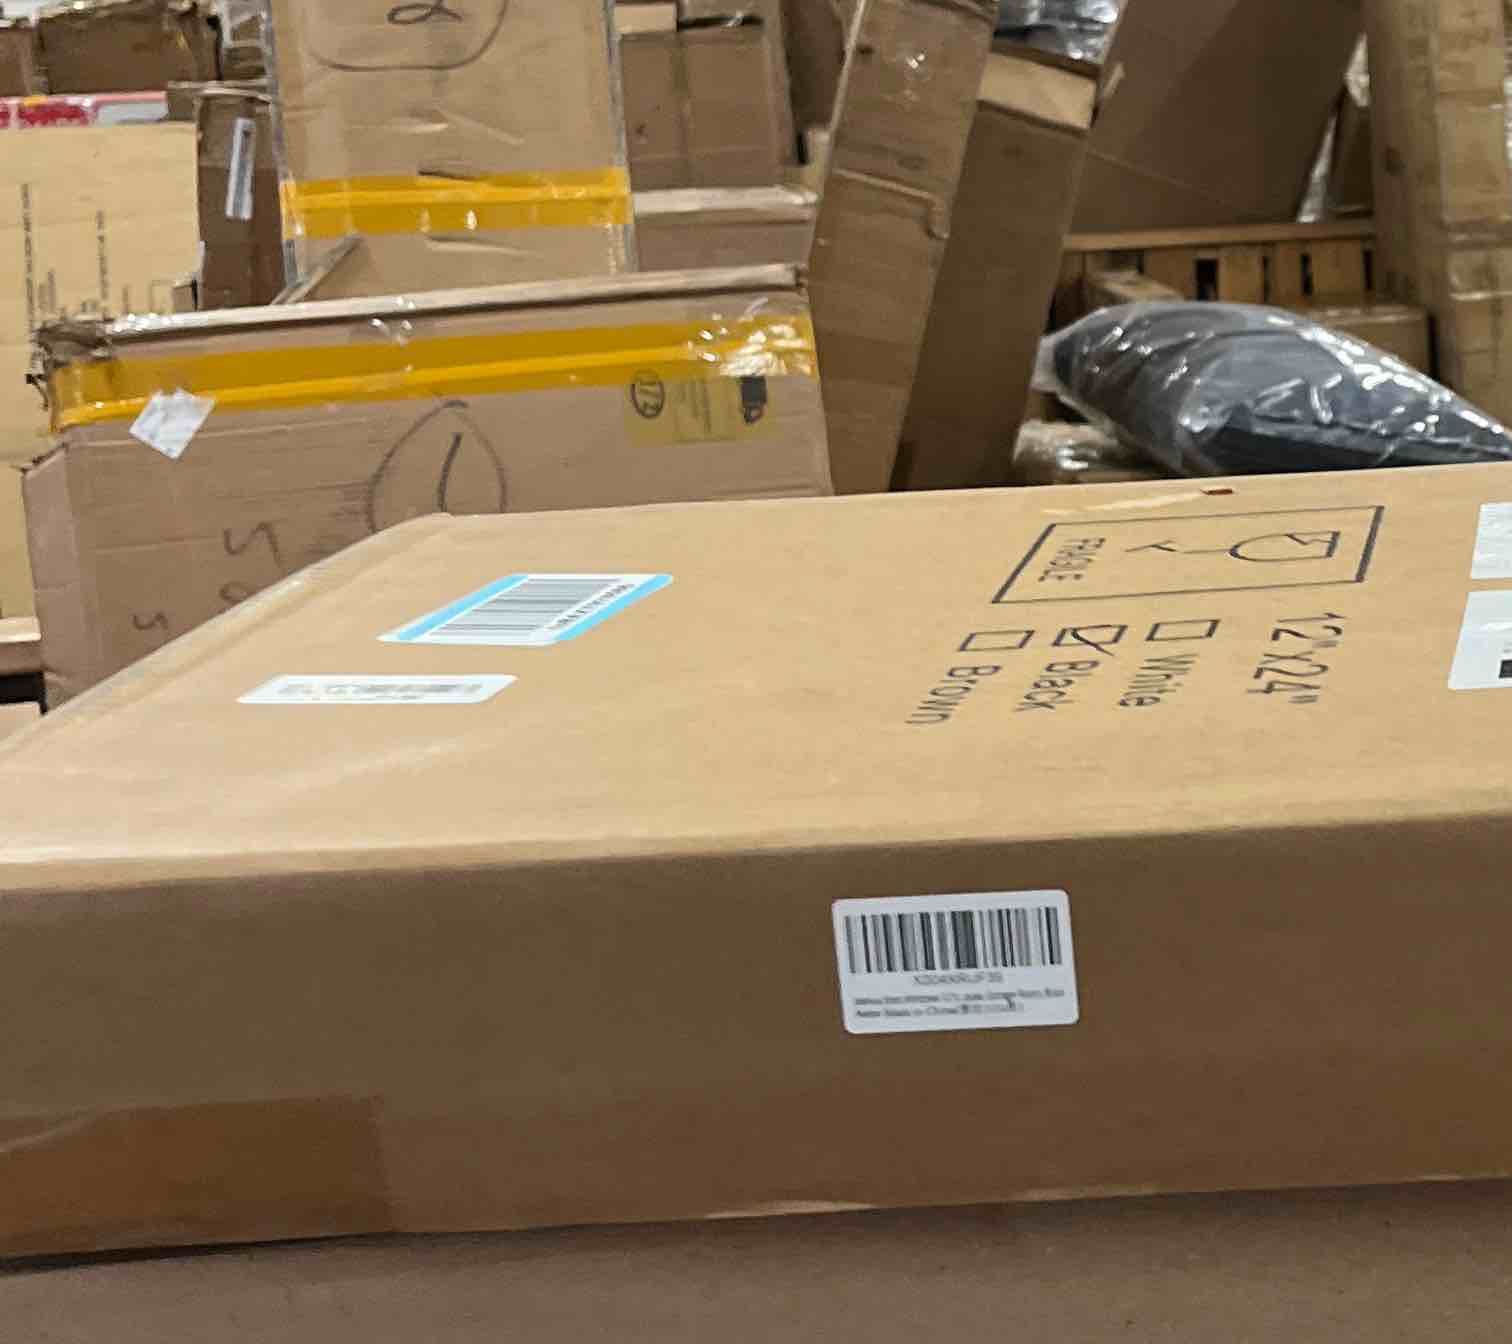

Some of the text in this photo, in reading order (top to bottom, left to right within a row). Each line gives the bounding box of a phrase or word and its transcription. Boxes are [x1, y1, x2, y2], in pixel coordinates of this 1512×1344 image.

[1037, 536, 1107, 583] FRAGILE
[904, 664, 1003, 725] Brown
[1012, 659, 1101, 713] Black
[1116, 652, 1201, 708] White
